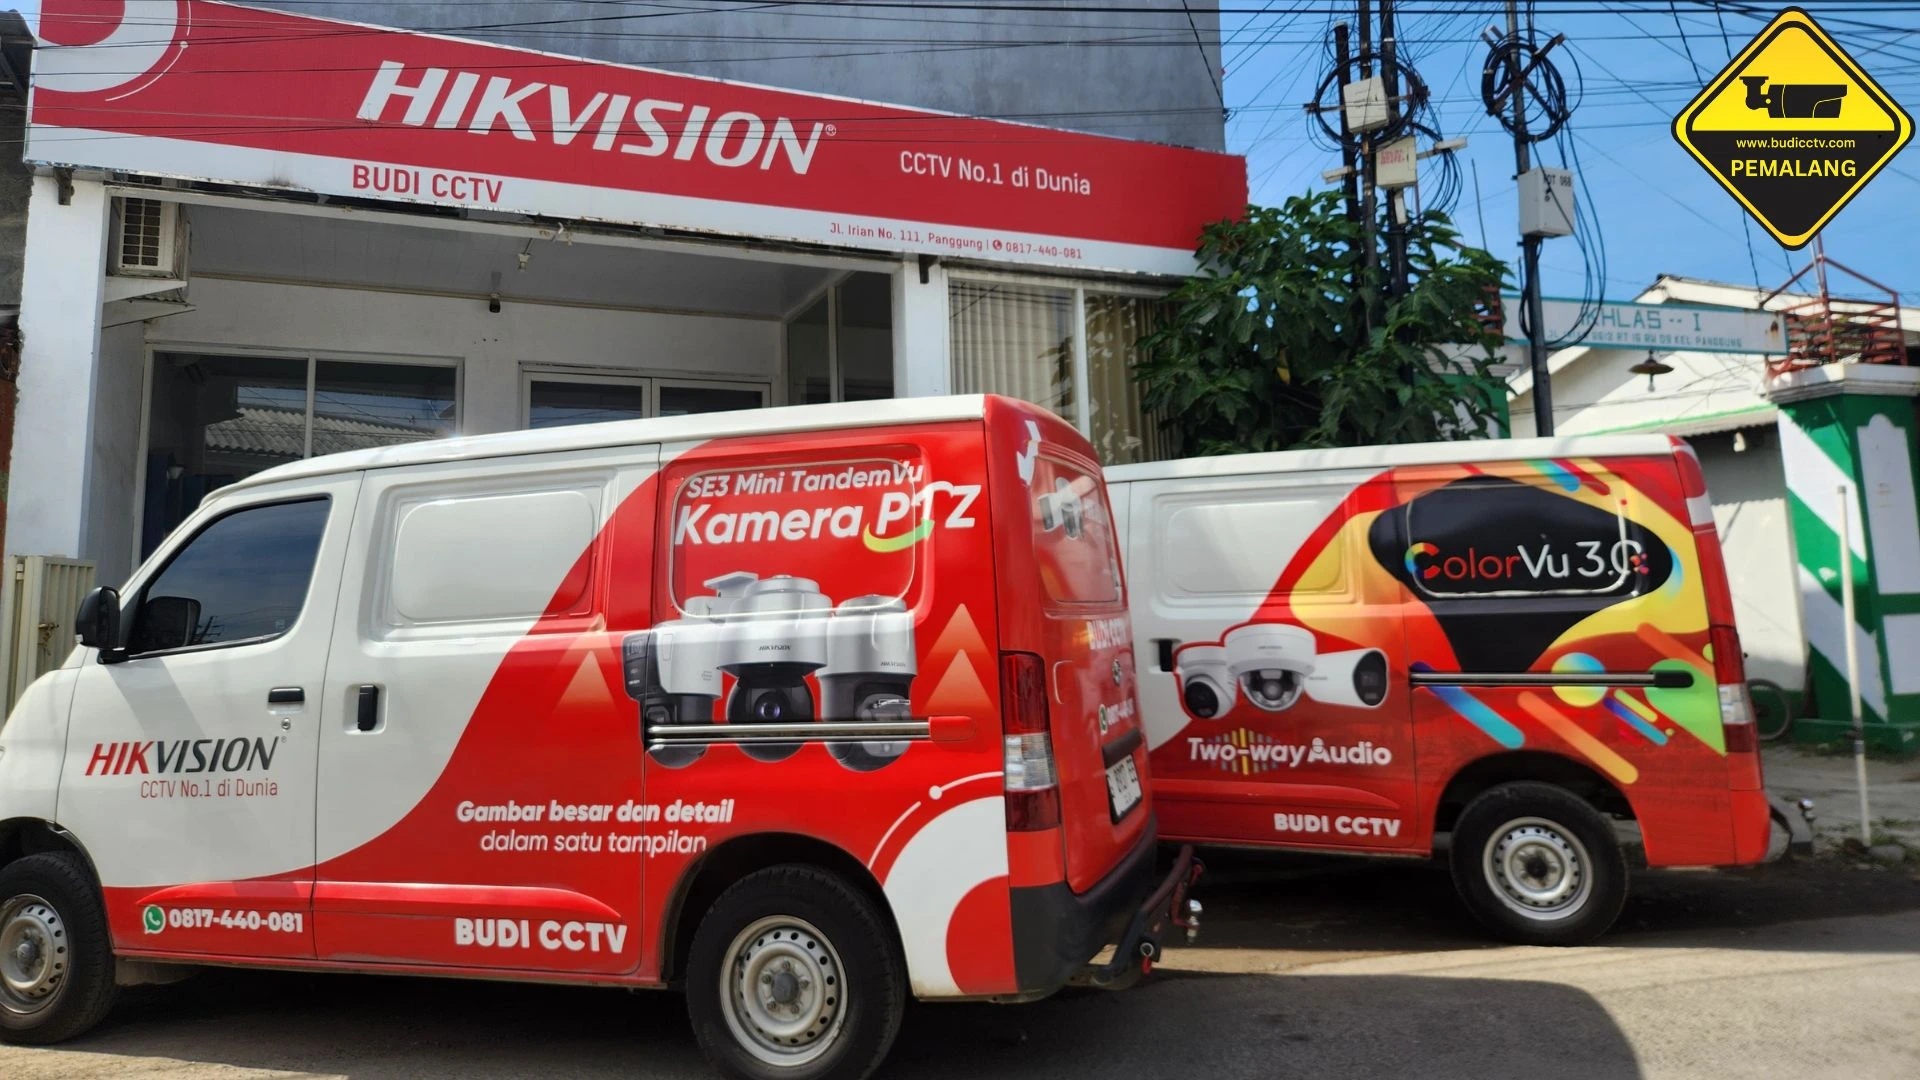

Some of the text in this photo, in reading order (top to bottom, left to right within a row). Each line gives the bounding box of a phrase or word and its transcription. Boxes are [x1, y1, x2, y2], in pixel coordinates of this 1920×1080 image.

[352, 164, 503, 203] BUDI CCTV
[900, 150, 1091, 196] CCTV No.1 di Dunia
[848, 225, 874, 238] Irian
[878, 227, 896, 240] No.
[928, 233, 983, 251] Panggung
[1005, 243, 1083, 260] 0817-440-081
[687, 460, 926, 499] SE3 Mini TandemVu
[675, 480, 982, 546] Kamera PTZ
[1404, 539, 1644, 580] ColorVu 3.0
[1187, 737, 1392, 768] Two-way Audio
[140, 777, 278, 798] CCTV No.1 di Dunia
[456, 798, 735, 823] Gambar besar dan detail
[1273, 813, 1401, 838] BUDI CCTV
[480, 829, 708, 858] dalam satu tampilan
[168, 908, 304, 933] 0817-440-081
[455, 918, 628, 954] BUDI CCTV
